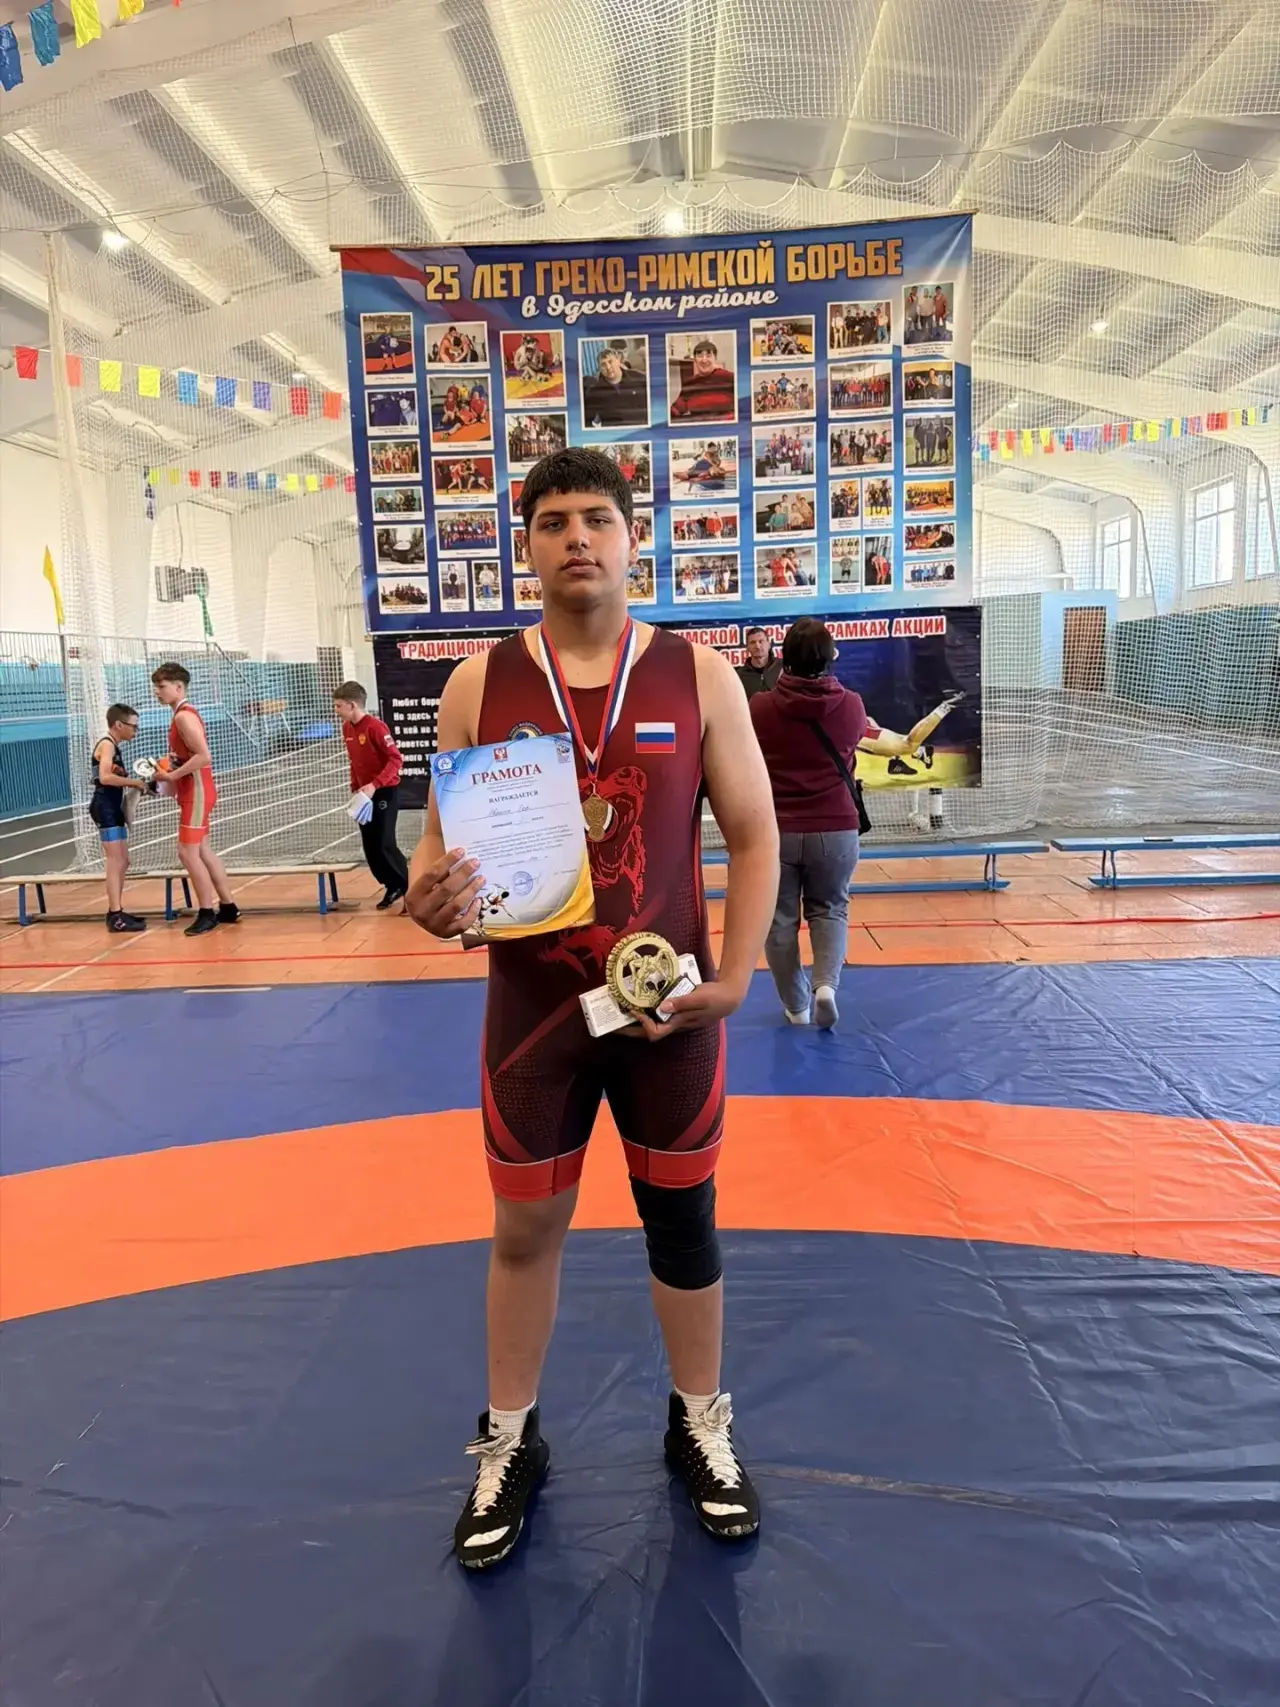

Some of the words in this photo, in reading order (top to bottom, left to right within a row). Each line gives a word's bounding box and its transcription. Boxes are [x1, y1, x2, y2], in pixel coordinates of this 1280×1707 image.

[425, 265, 461, 300] 25
[472, 263, 525, 299] ЛЕТ
[535, 240, 775, 296] ГРЕКО-РИМСКОЙ
[786, 239, 903, 283] БОРЬБЕ
[521, 295, 540, 318] в
[547, 292, 676, 324] Одесском
[676, 288, 779, 318] районе
[893, 617, 945, 637] АКЦИИ
[392, 698, 418, 707] Любят
[393, 712, 405, 721] Но
[394, 726, 401, 735] В
[471, 763, 543, 785] ГРАМОТА
[488, 790, 539, 804] НАГРАЖДАЕТСЯ
